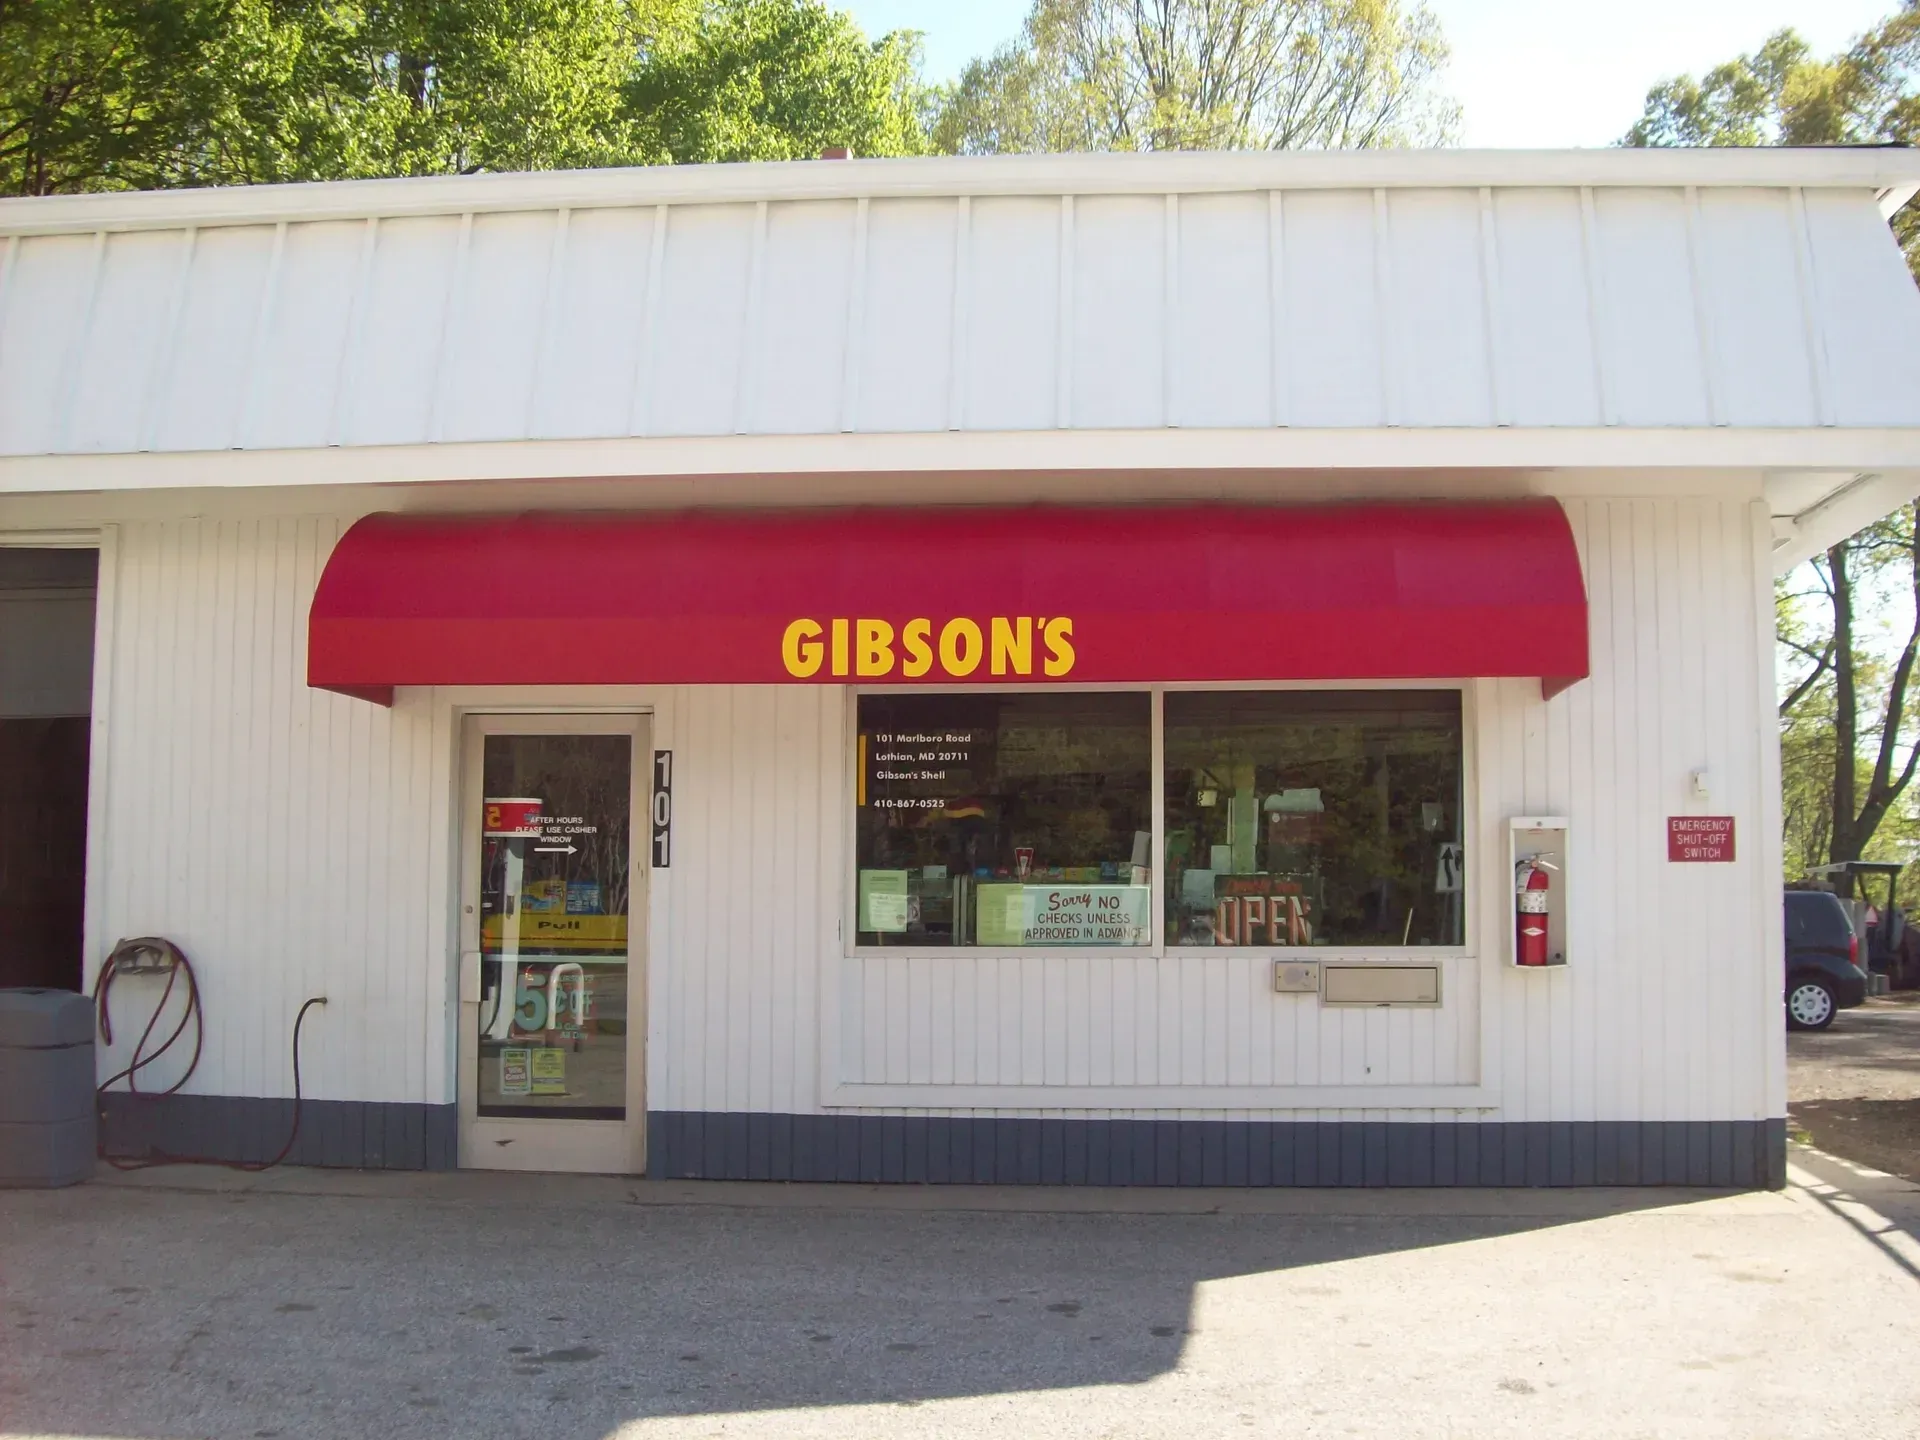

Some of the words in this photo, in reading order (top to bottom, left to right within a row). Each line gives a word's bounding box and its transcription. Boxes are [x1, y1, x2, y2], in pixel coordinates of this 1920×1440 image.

[781, 616, 1076, 678] GIBSON'S
[875, 734, 893, 743] 101
[896, 733, 943, 743] Marlboro
[945, 733, 971, 743] Road
[875, 752, 916, 762] Lothian,
[918, 752, 936, 761] MD
[938, 752, 969, 761] 20711
[876, 770, 918, 780] Gibson's
[920, 770, 945, 780] Shell
[874, 798, 945, 808] 410-867-0525
[654, 752, 671, 866] 101
[530, 816, 554, 824] AFTER
[556, 816, 583, 824] HOURS
[1672, 820, 1731, 831] EMERGENCY
[515, 826, 544, 834] PLEASE
[546, 826, 562, 834] USE
[564, 826, 597, 834] CASHIER
[1677, 833, 1727, 844] SHUT-OFF
[1684, 847, 1721, 858] SWITCH
[1048, 891, 1092, 911] Sorry
[1098, 896, 1120, 909] NO
[1037, 912, 1083, 925] CHECKS
[1087, 912, 1131, 925] UNLESS
[1216, 896, 1312, 945] OPEN
[538, 921, 580, 930] Pull
[1024, 926, 1080, 940] APPROVED
[1083, 927, 1093, 939] IN
